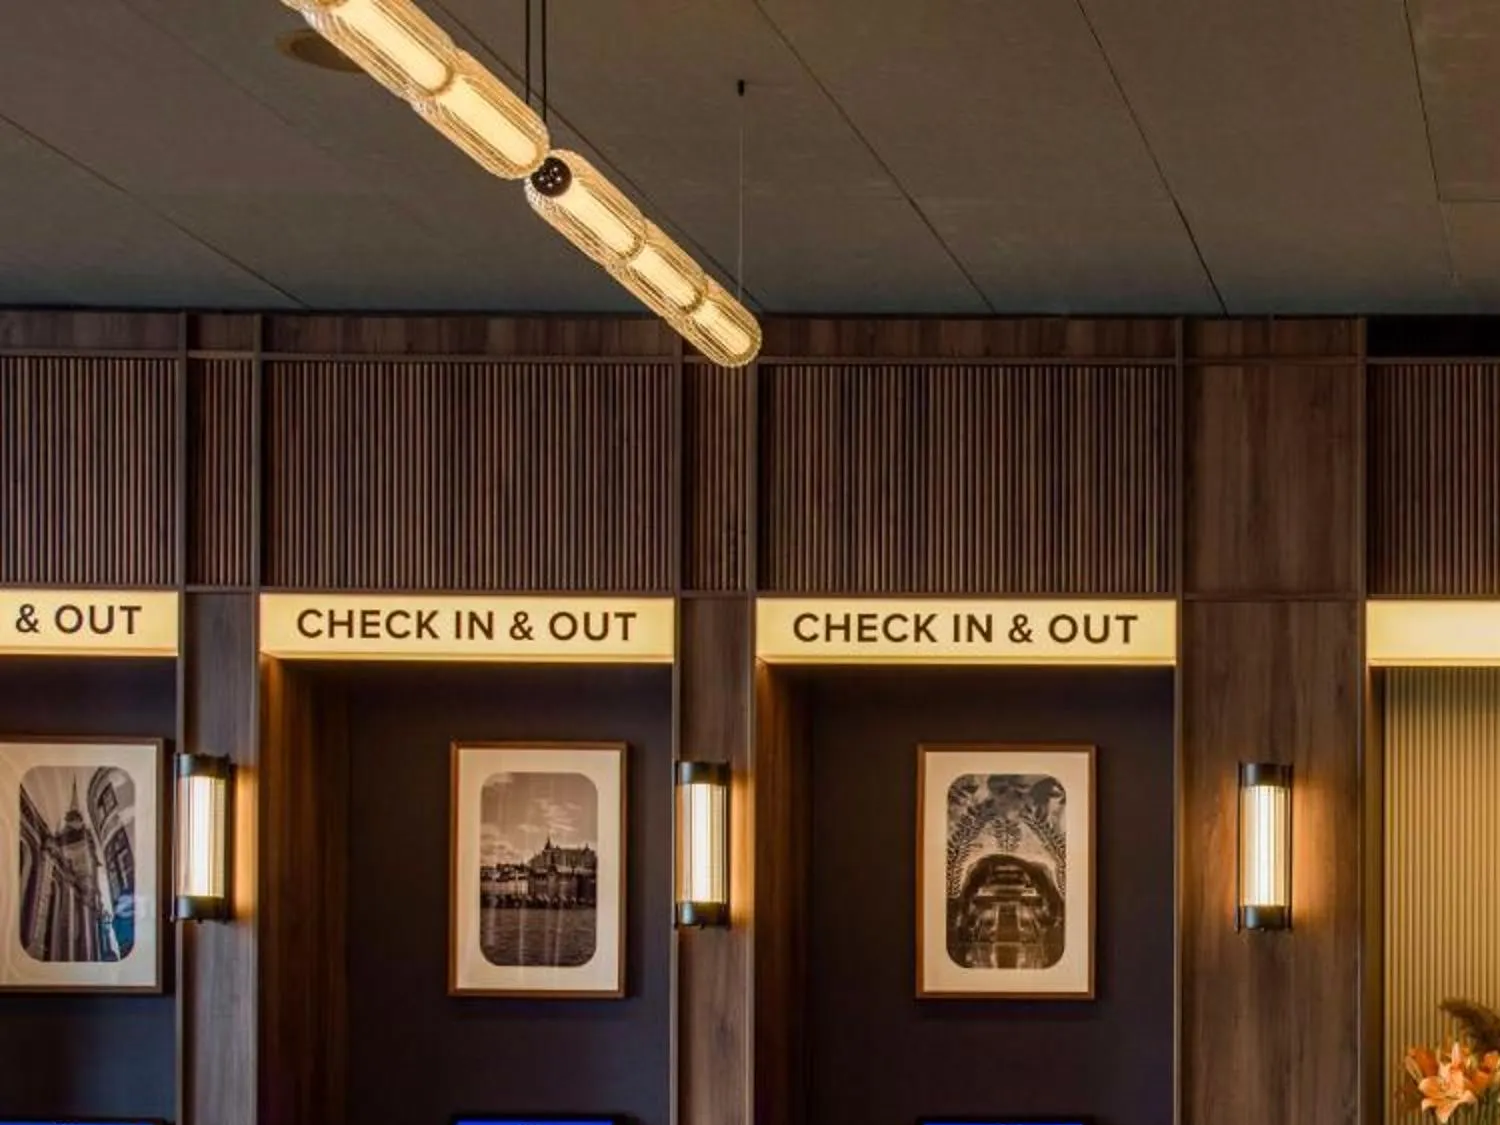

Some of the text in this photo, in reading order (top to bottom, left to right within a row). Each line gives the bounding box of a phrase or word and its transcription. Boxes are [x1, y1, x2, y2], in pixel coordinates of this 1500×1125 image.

[15, 603, 143, 635] & OUT
[297, 608, 637, 642] CHECK IN & OUT
[793, 612, 1139, 645] CHECK IN & OUT
